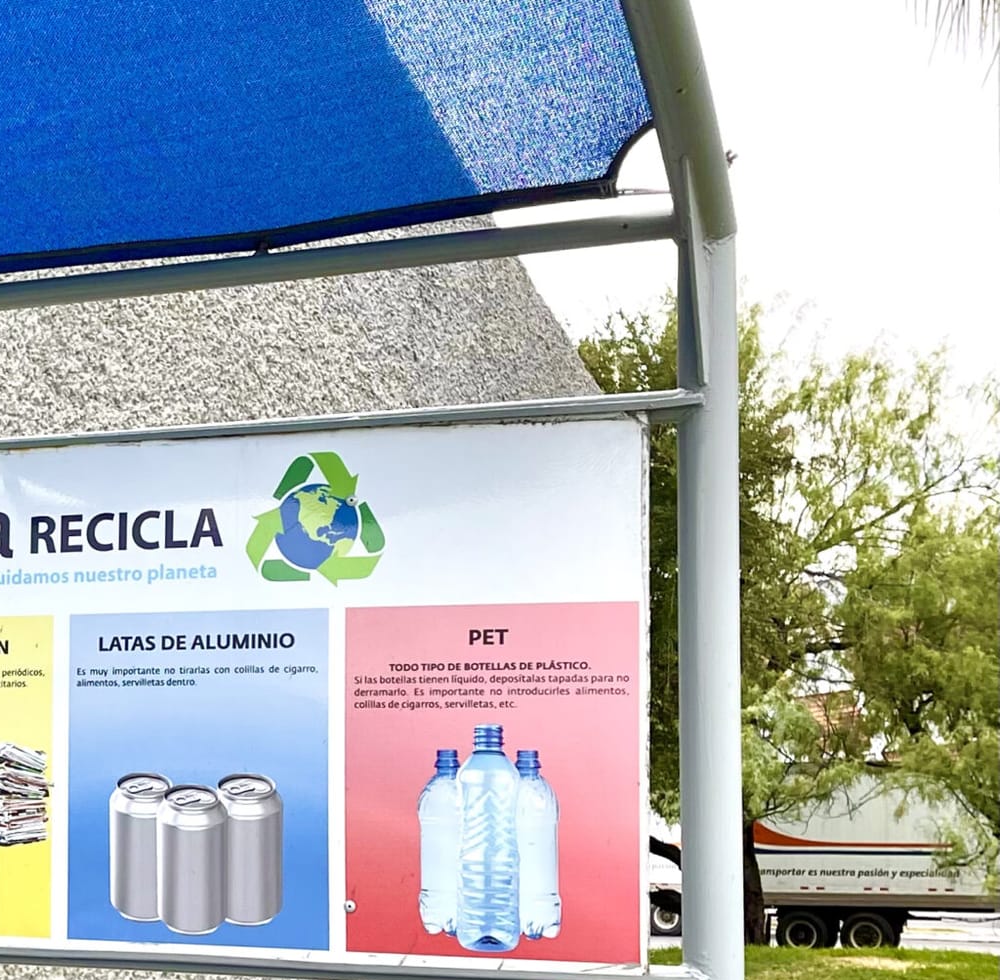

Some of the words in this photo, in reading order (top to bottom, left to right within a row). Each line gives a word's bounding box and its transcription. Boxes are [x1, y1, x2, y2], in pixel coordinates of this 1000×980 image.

[30, 508, 223, 554] RECICLA
[74, 565, 143, 586] nuestro
[147, 563, 217, 583] planeta
[99, 636, 155, 651] LATAS
[161, 635, 186, 650] DE
[191, 633, 295, 650] ALUMINIO
[469, 629, 508, 645] PET
[90, 669, 107, 677] muy
[112, 667, 160, 676] importante
[269, 665, 279, 673] de
[284, 665, 318, 675] cigarro,
[390, 663, 419, 671] TODO
[422, 663, 445, 671] TIPO
[448, 663, 462, 671] DE
[464, 662, 516, 671] BOTELLAS
[519, 662, 534, 670] DE
[536, 660, 591, 670] PLÁSTICO.
[2, 668, 45, 678] periódicos,
[77, 679, 120, 687] alimentos,
[122, 679, 164, 687] servilletas
[167, 678, 197, 686] dentro.
[355, 676, 362, 684] Si
[364, 676, 377, 684] las
[380, 676, 416, 684] botellas
[419, 675, 449, 684] tienen
[451, 675, 487, 685] líquido,
[548, 674, 588, 684] tapadas
[591, 676, 613, 684] para
[354, 688, 409, 696] derramarlo.
[414, 688, 424, 696] Es
[430, 688, 484, 697] importante
[576, 687, 630, 695] alimentos,
[388, 700, 399, 708] de
[402, 700, 442, 710] cigarros,
[445, 700, 496, 709] servilletas,
[760, 868, 805, 878] ansportar
[858, 868, 889, 878] pasión
[891, 871, 896, 879] y
